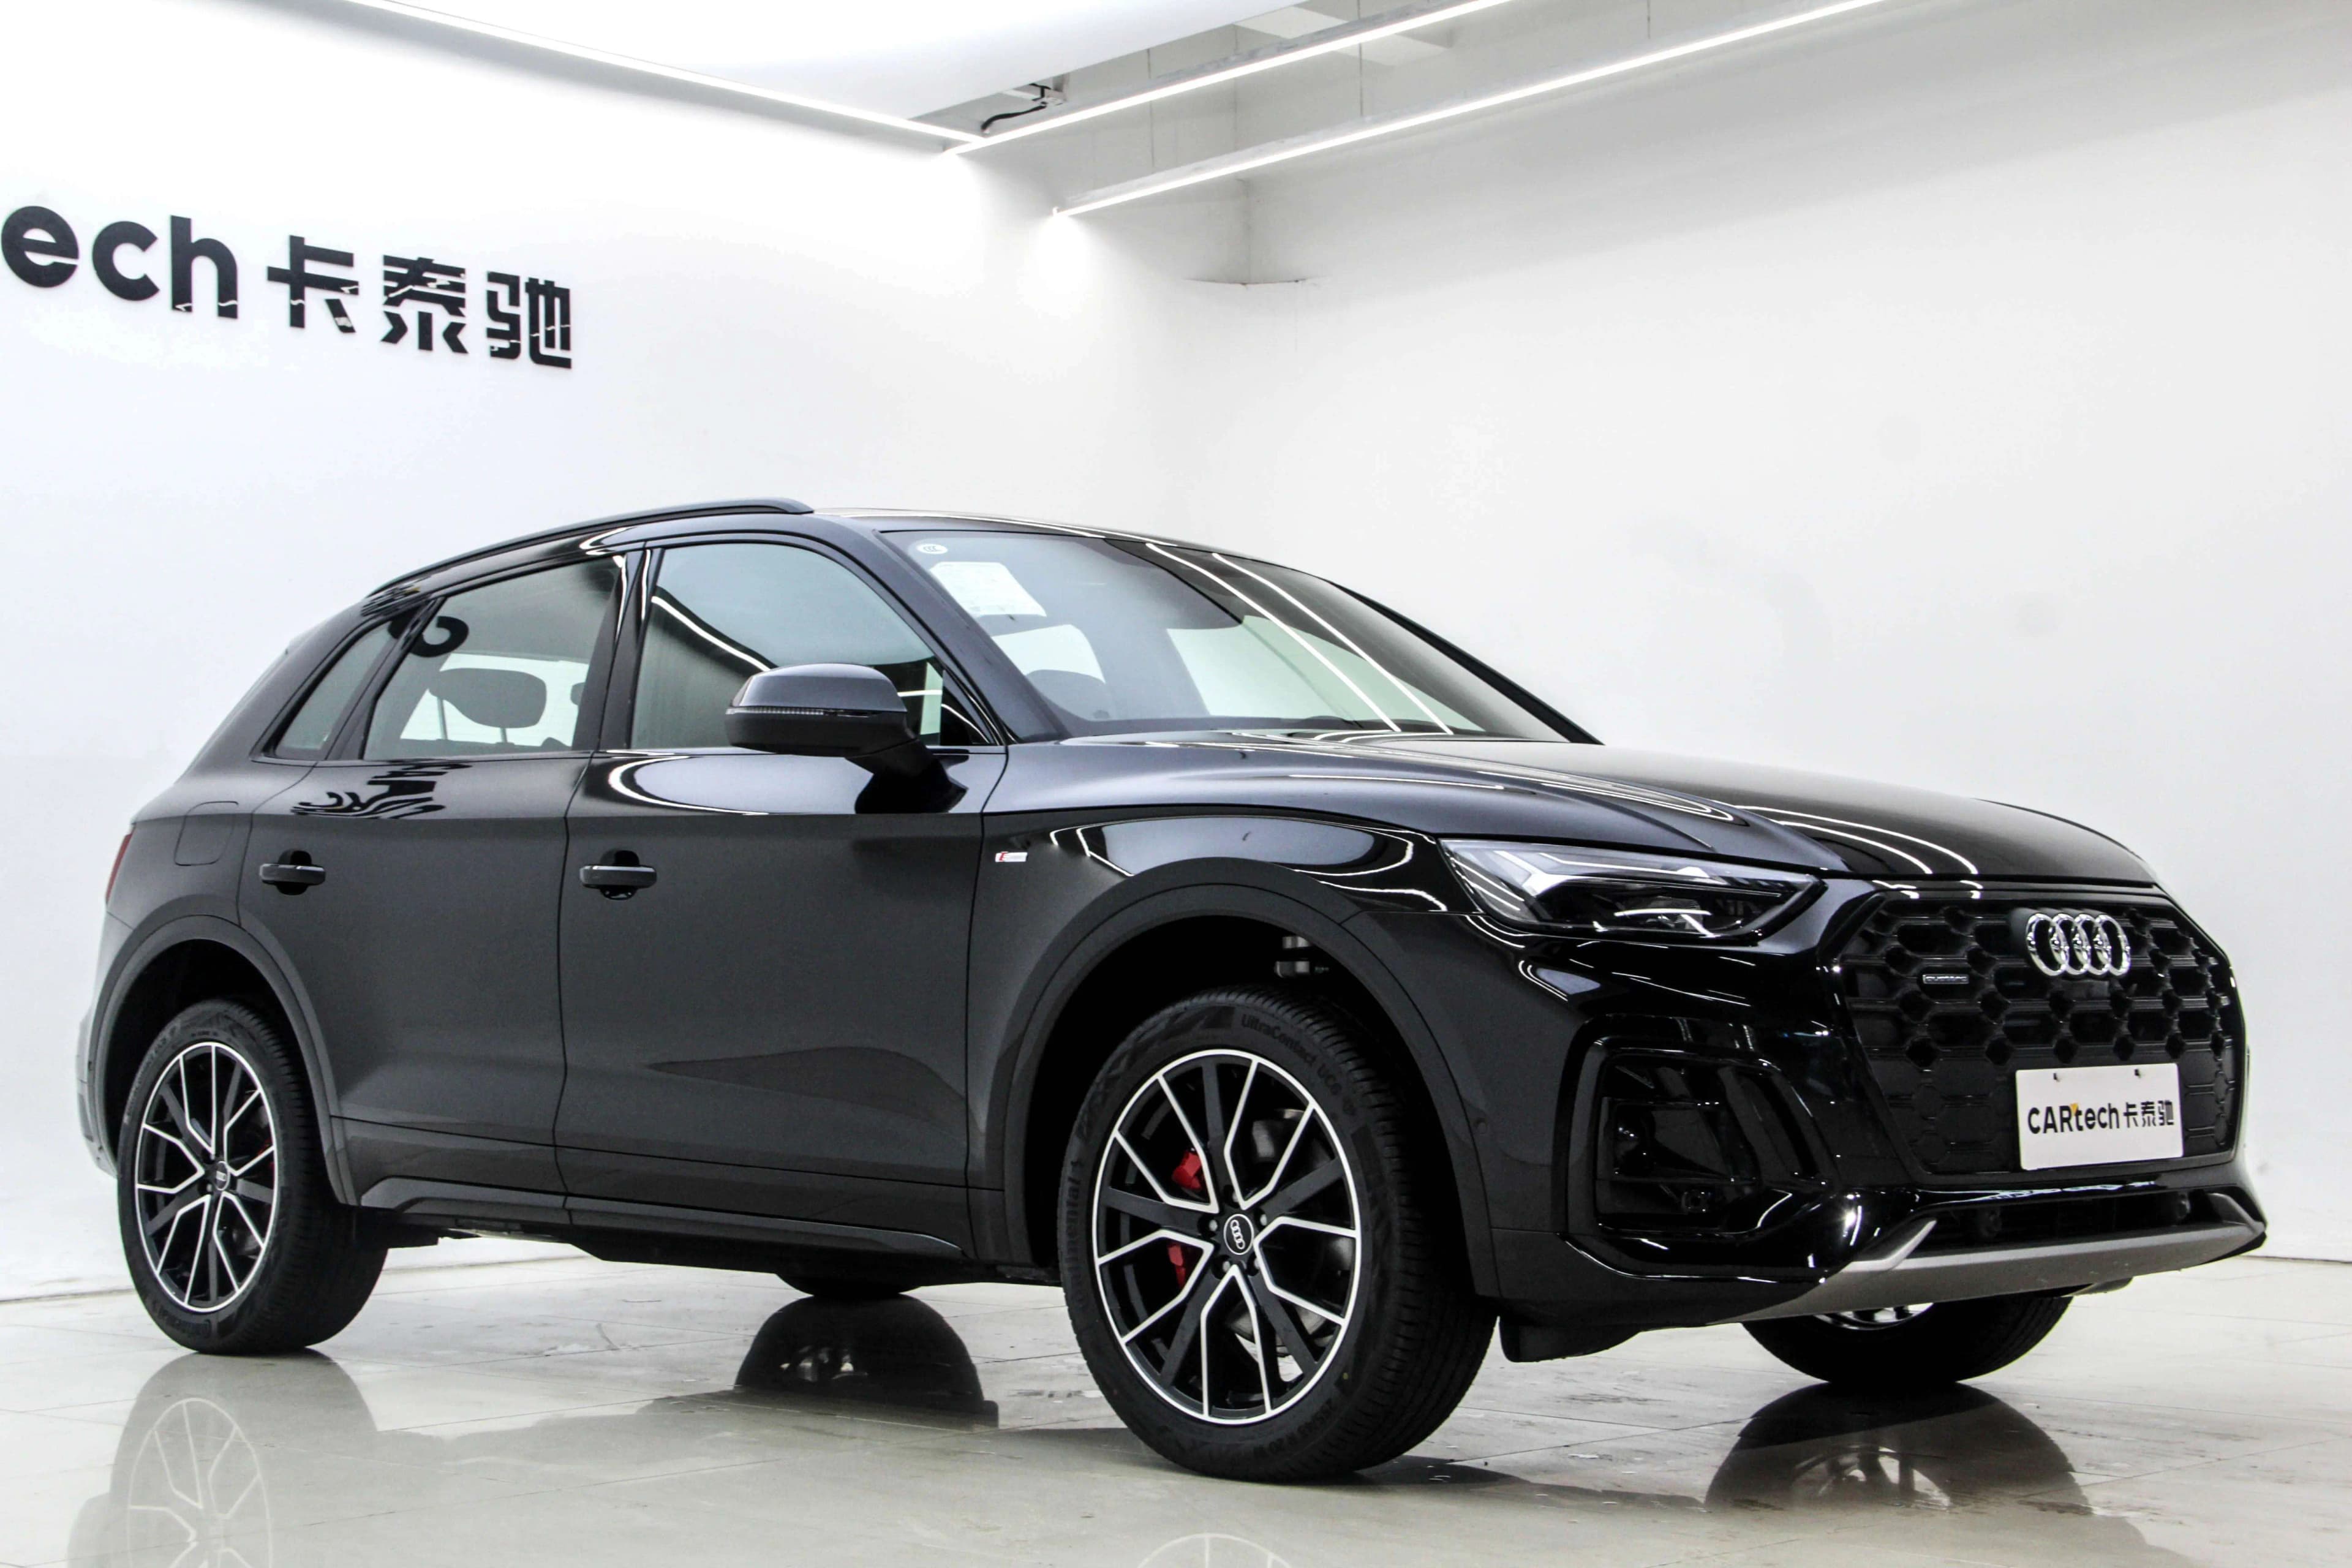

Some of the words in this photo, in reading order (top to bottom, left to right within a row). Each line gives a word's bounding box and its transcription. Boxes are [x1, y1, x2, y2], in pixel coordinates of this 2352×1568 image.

[1, 205, 238, 319] ech
[267, 235, 571, 369] 卡泰驰
